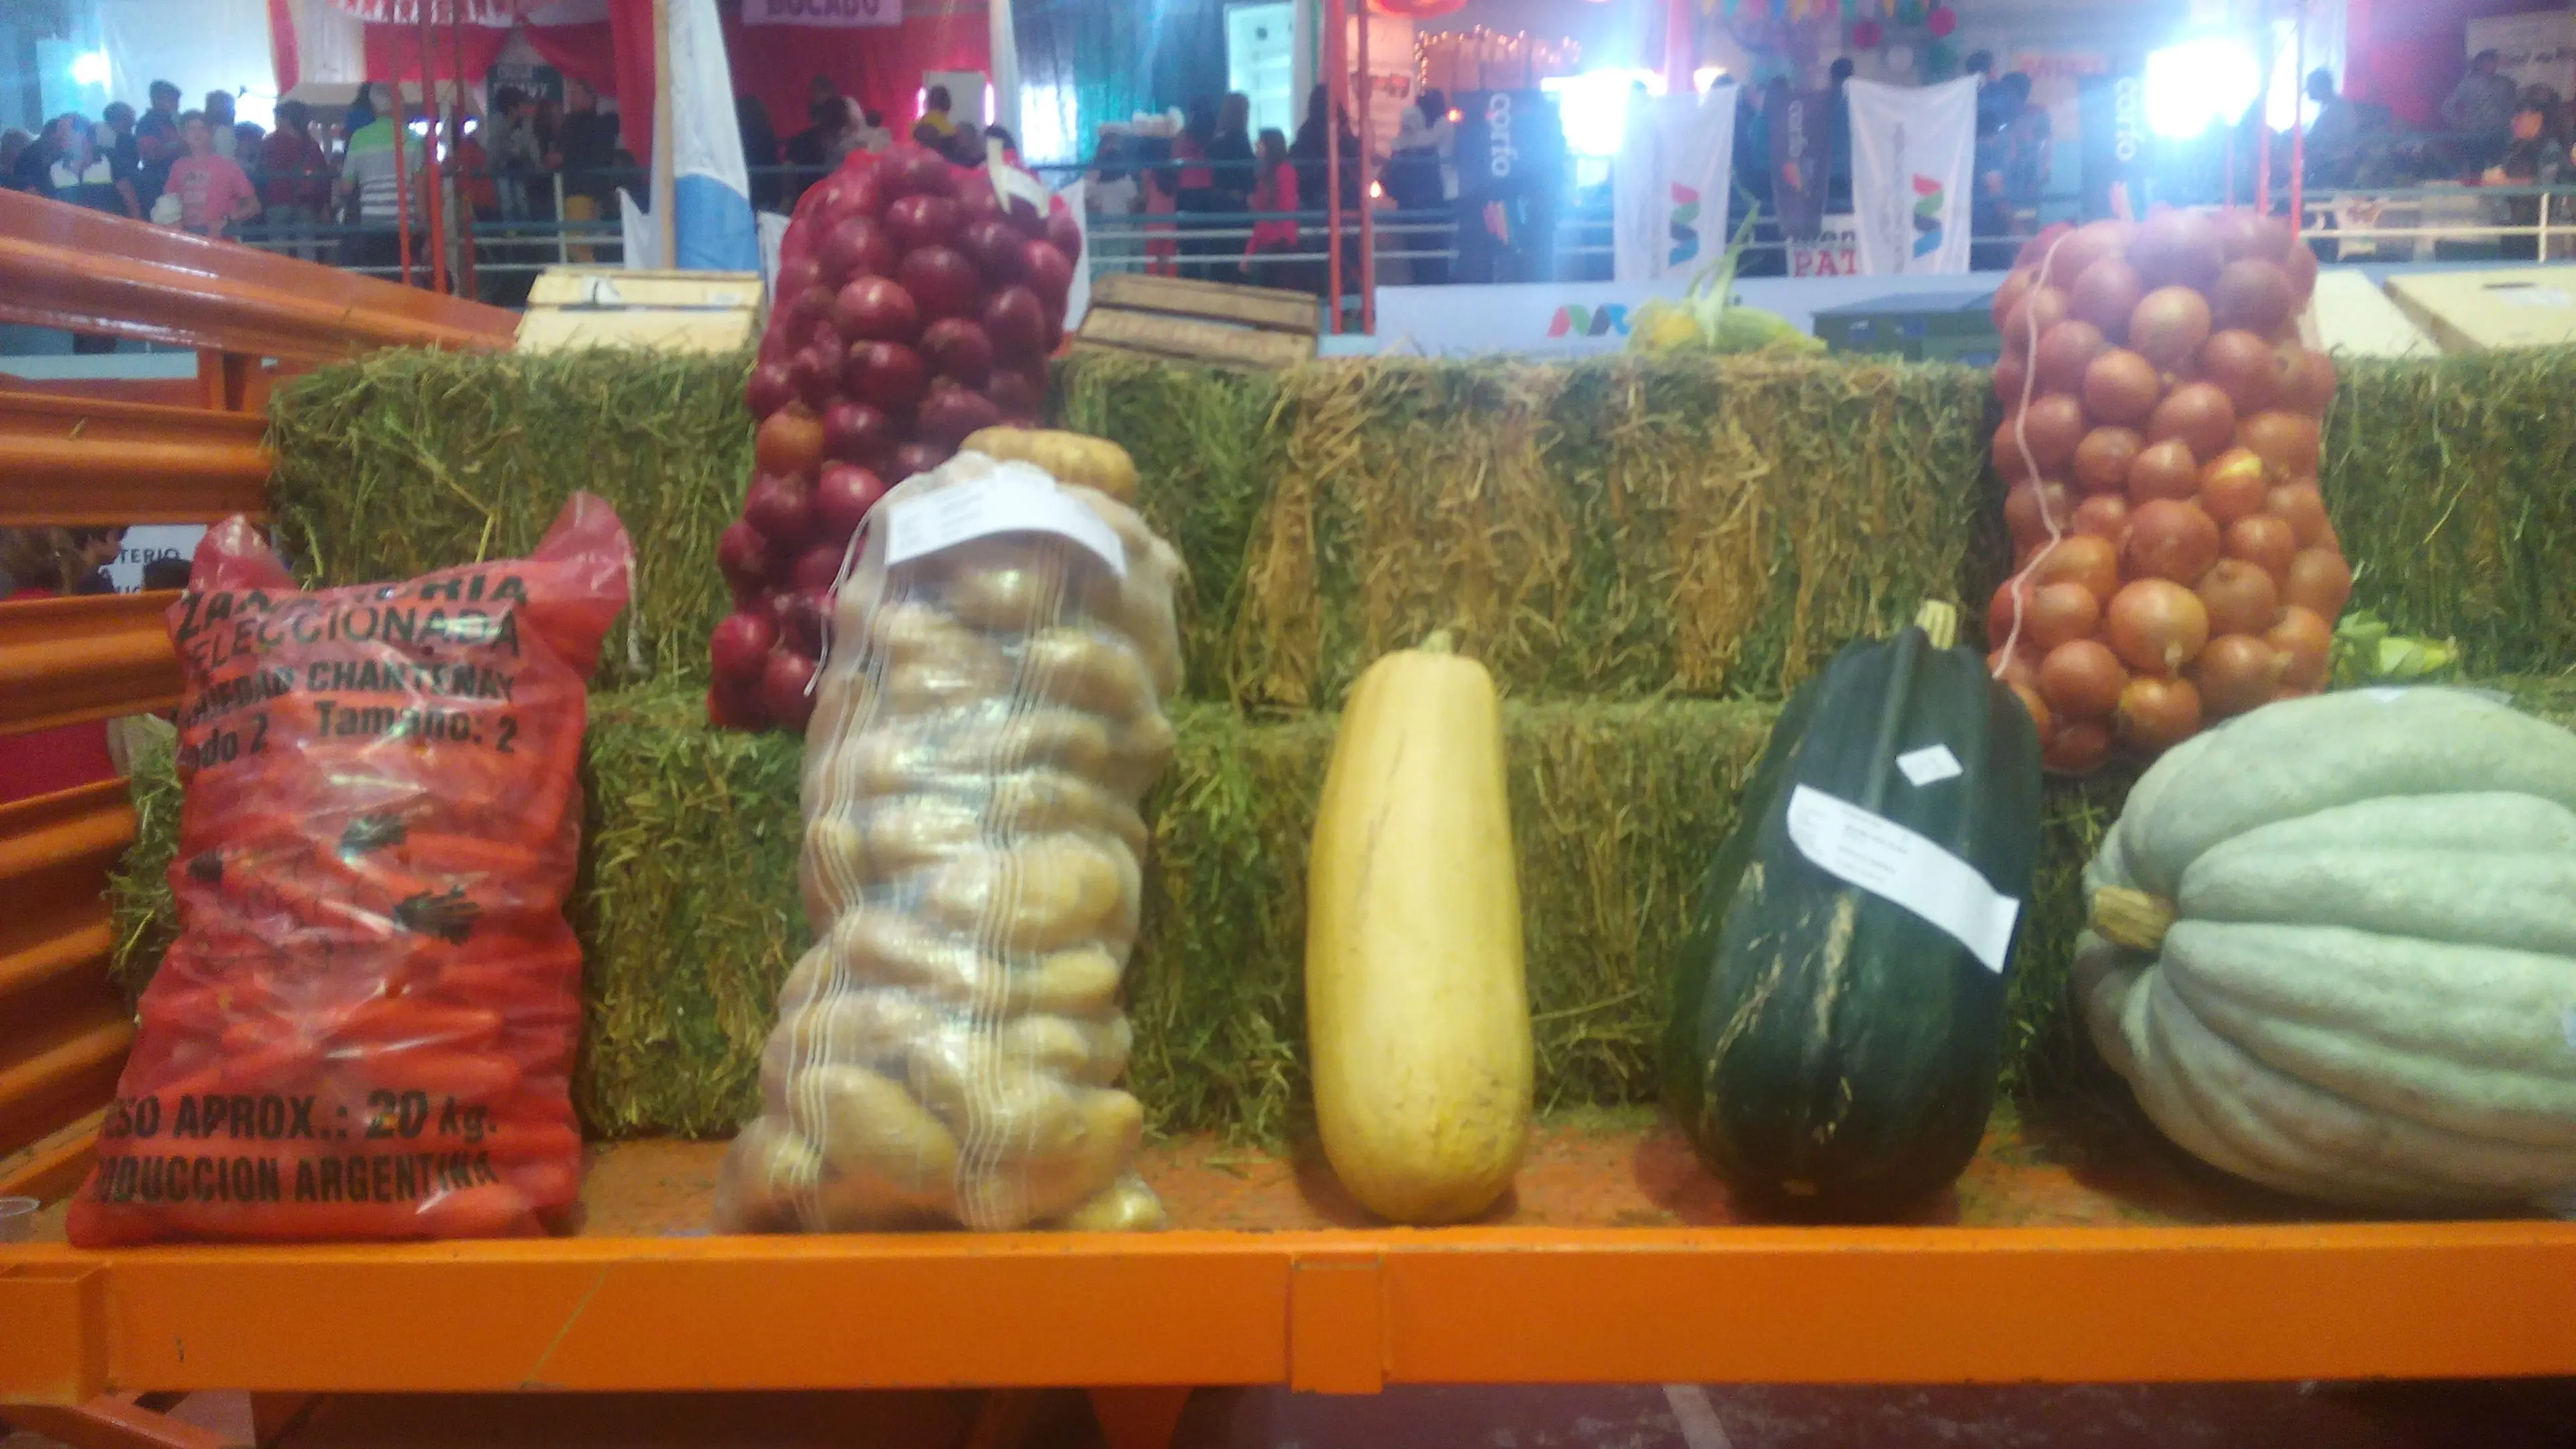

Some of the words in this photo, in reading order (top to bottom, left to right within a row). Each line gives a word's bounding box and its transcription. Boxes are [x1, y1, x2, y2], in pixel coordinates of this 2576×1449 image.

[1489, 92, 1519, 178] corfo
[249, 711, 270, 756] 2
[496, 714, 519, 755] 2
[366, 1088, 431, 1139] 20
[292, 1150, 499, 1203] ARGENTINA
